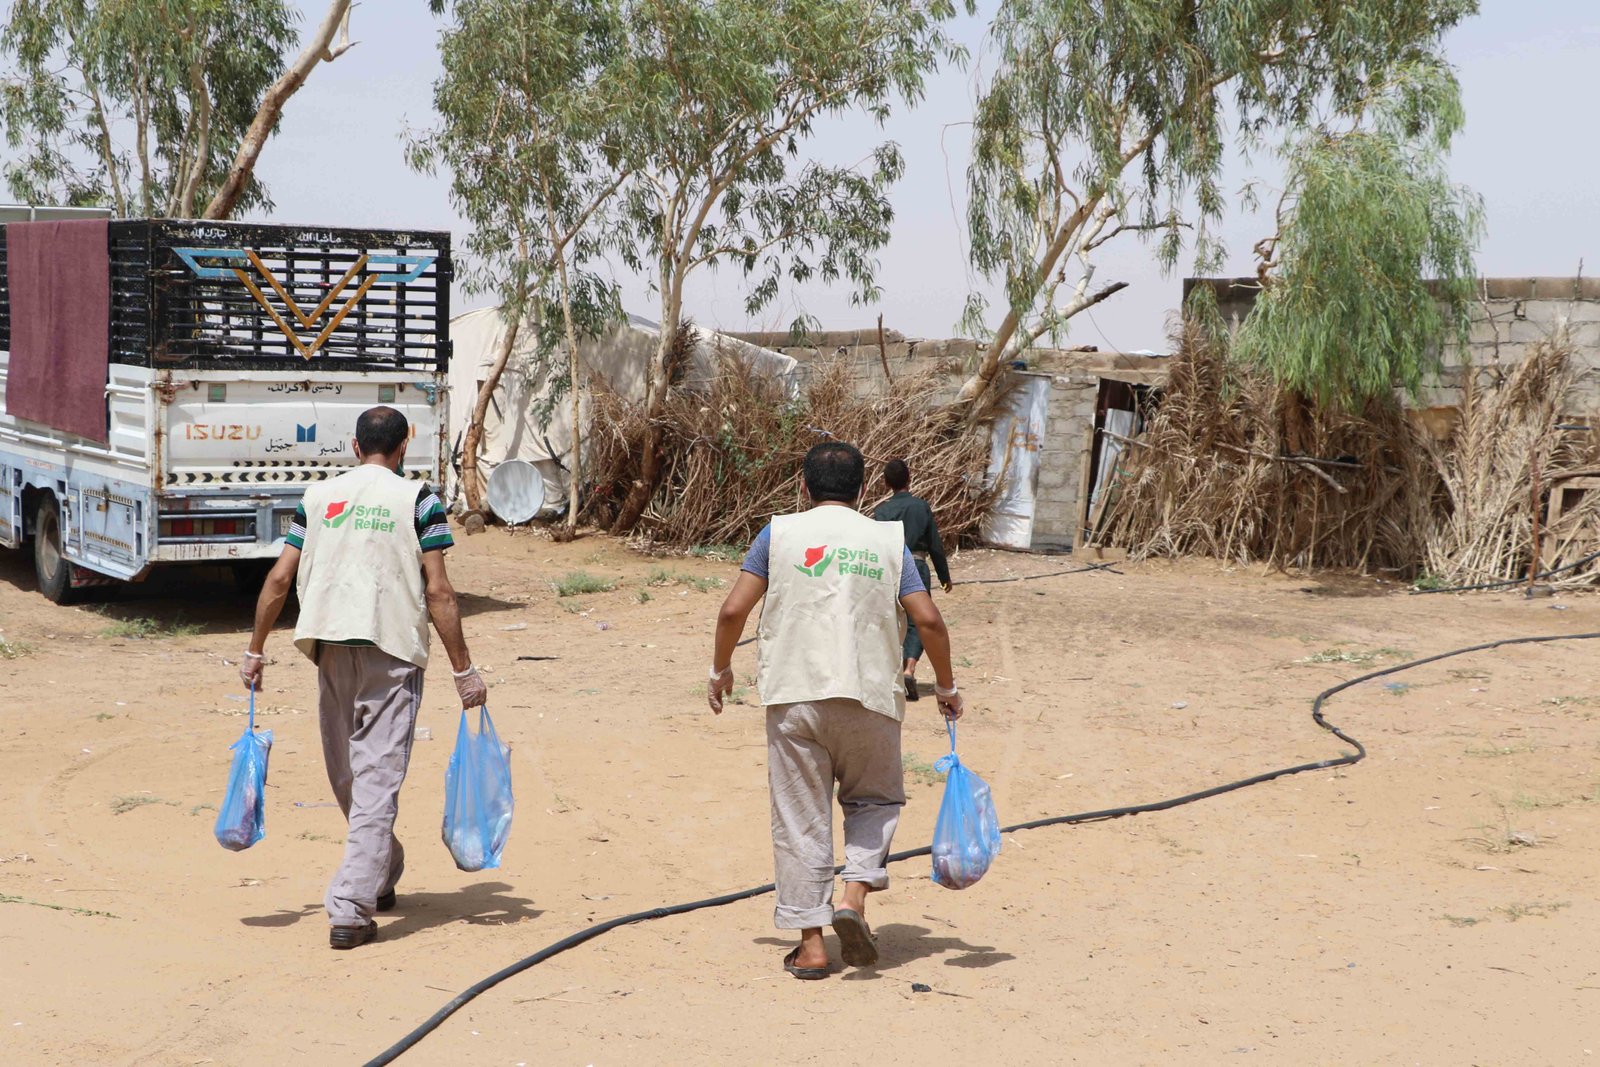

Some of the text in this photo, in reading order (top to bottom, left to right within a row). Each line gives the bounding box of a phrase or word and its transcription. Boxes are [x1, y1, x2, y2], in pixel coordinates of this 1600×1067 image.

[335, 384, 343, 395] لا
[186, 425, 261, 441] ISUZU
[318, 440, 346, 456] الصبر
[356, 505, 390, 518] Syria
[355, 519, 395, 532] Relief
[838, 548, 878, 562] Syria
[839, 563, 884, 580] Relief
